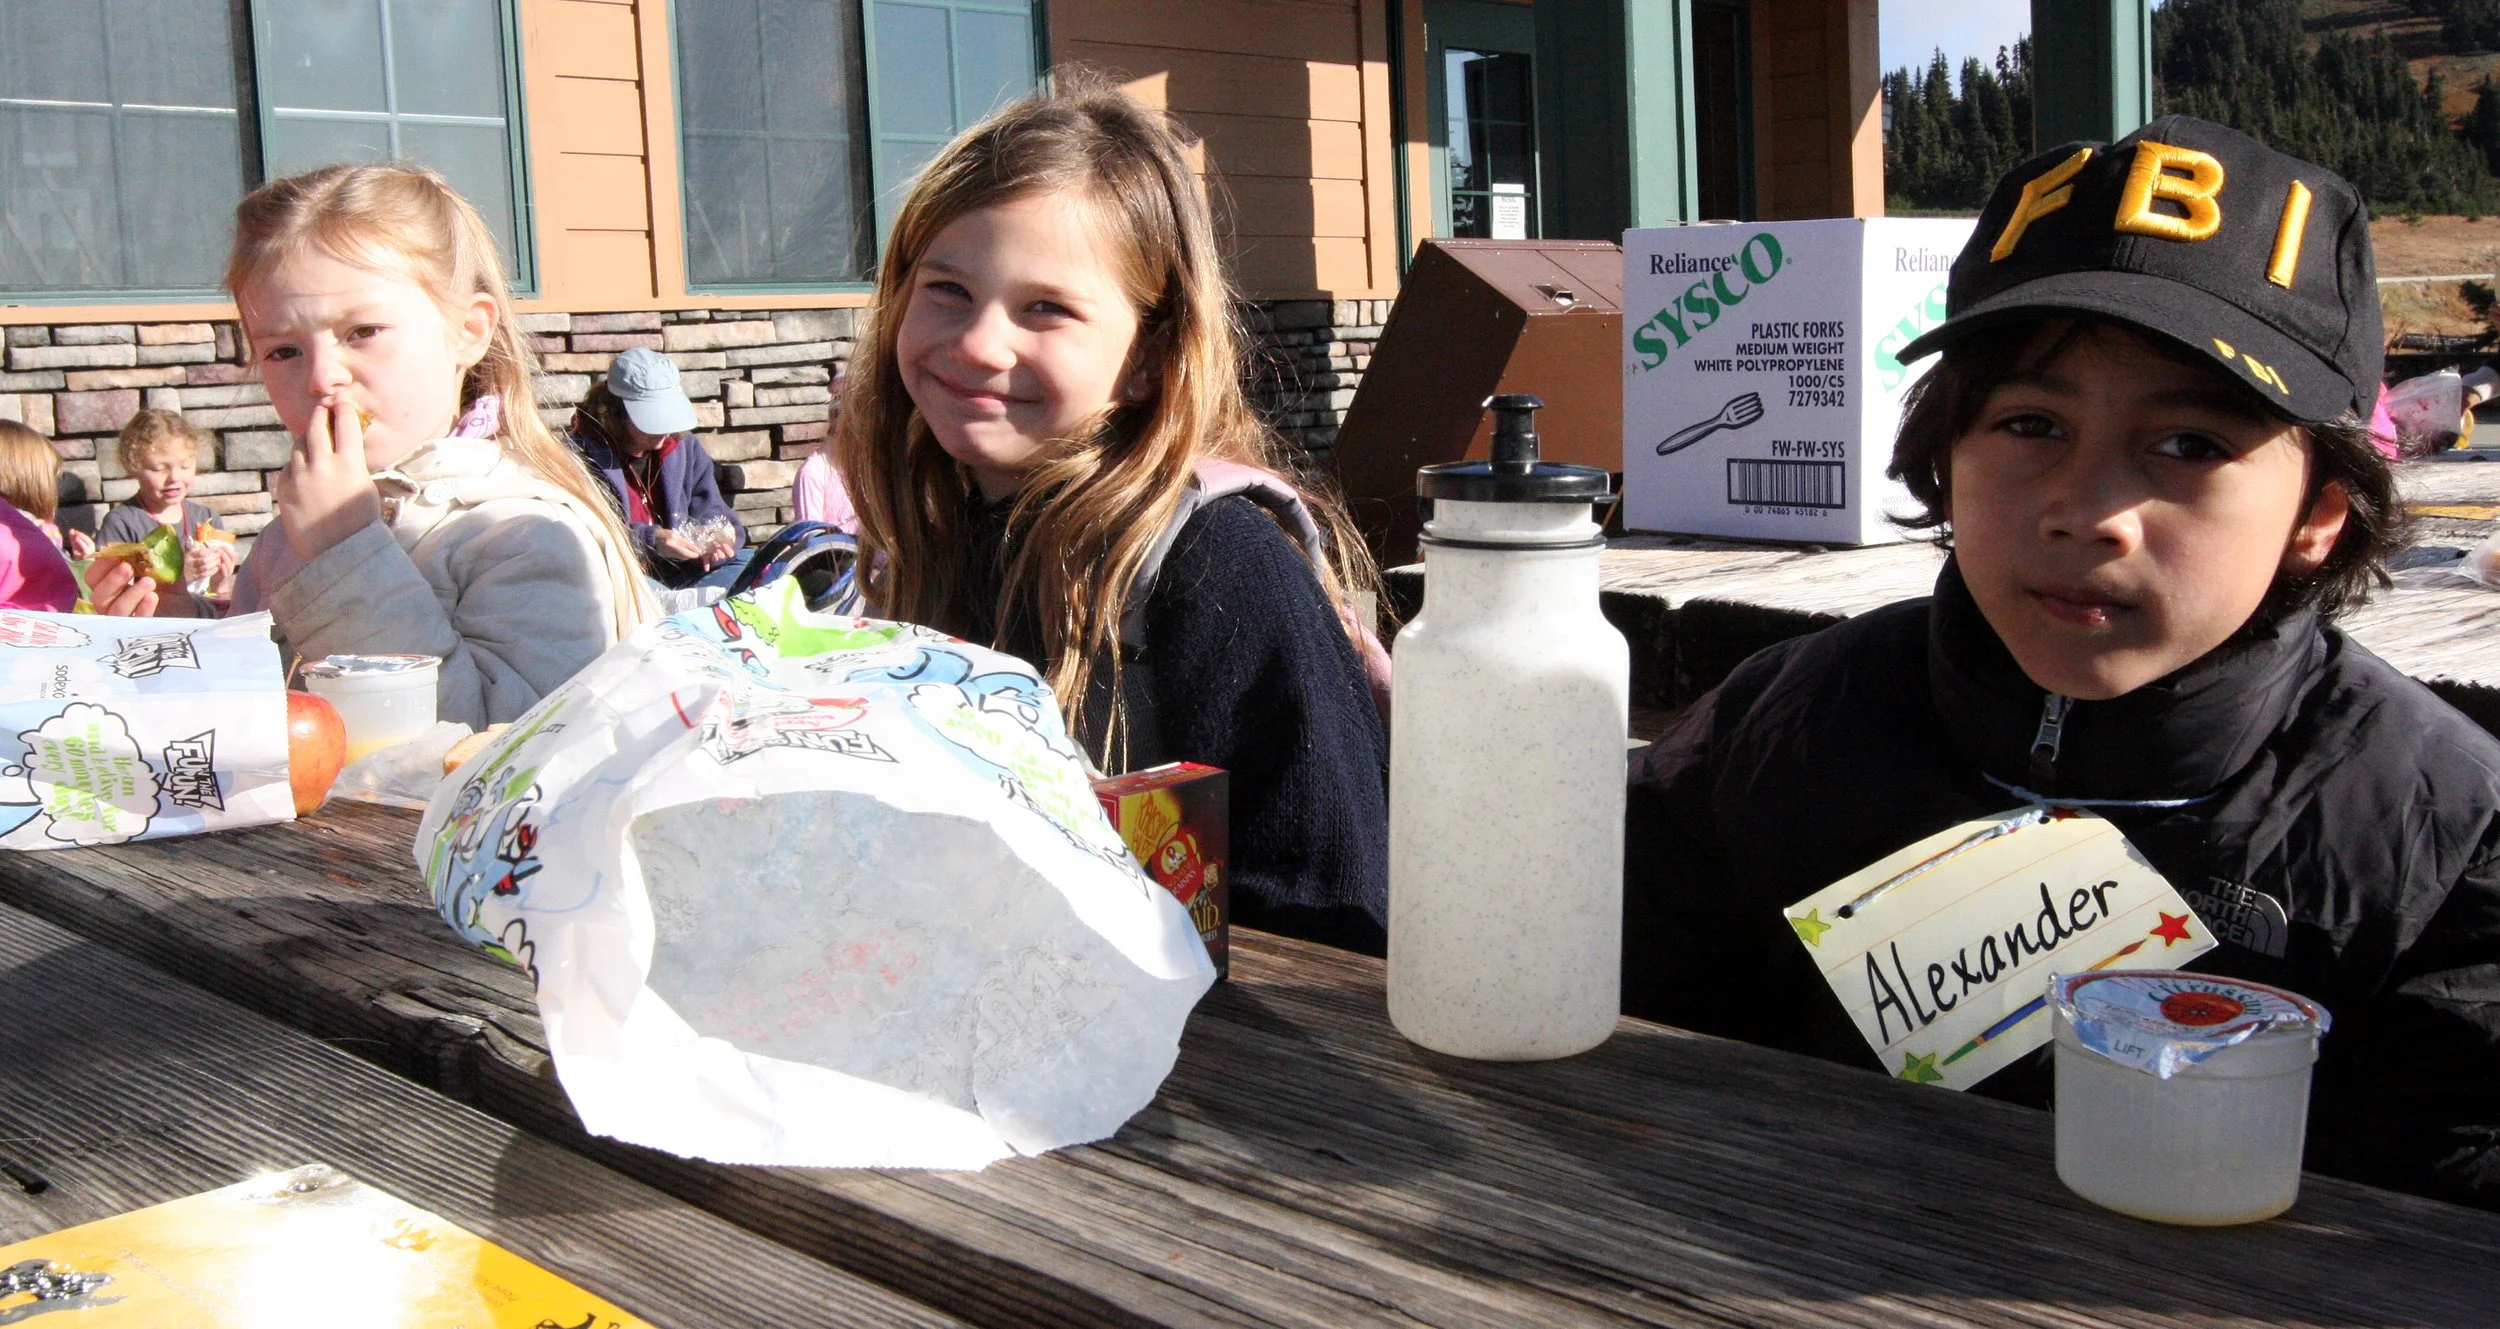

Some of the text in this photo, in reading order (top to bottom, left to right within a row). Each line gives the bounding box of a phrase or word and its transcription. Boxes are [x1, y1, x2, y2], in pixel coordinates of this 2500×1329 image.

[1989, 139, 2312, 290] FBI
[1650, 253, 1732, 275] Reliance
[1894, 246, 1957, 273] Relian
[1632, 232, 1783, 373] SYSCO
[1751, 321, 1845, 340] PLASTIC FORKS
[1735, 341, 1845, 356] MEDIUM WEIGHT
[1694, 359, 1845, 372] WHITE POLYPROPYLENE
[1788, 375, 1845, 388] 1000/CS
[1788, 390, 1845, 408] 7279342
[1771, 440, 1845, 458] FW-FW-SYS
[52, 664, 71, 698] sodexo
[785, 730, 876, 754] FUN
[41, 740, 67, 773] every
[199, 777, 214, 795] THE
[2208, 876, 2257, 907] THE
[2182, 888, 2252, 926] ORTH
[2201, 914, 2246, 944] ACE
[2113, 1039, 2146, 1060] LIFT
